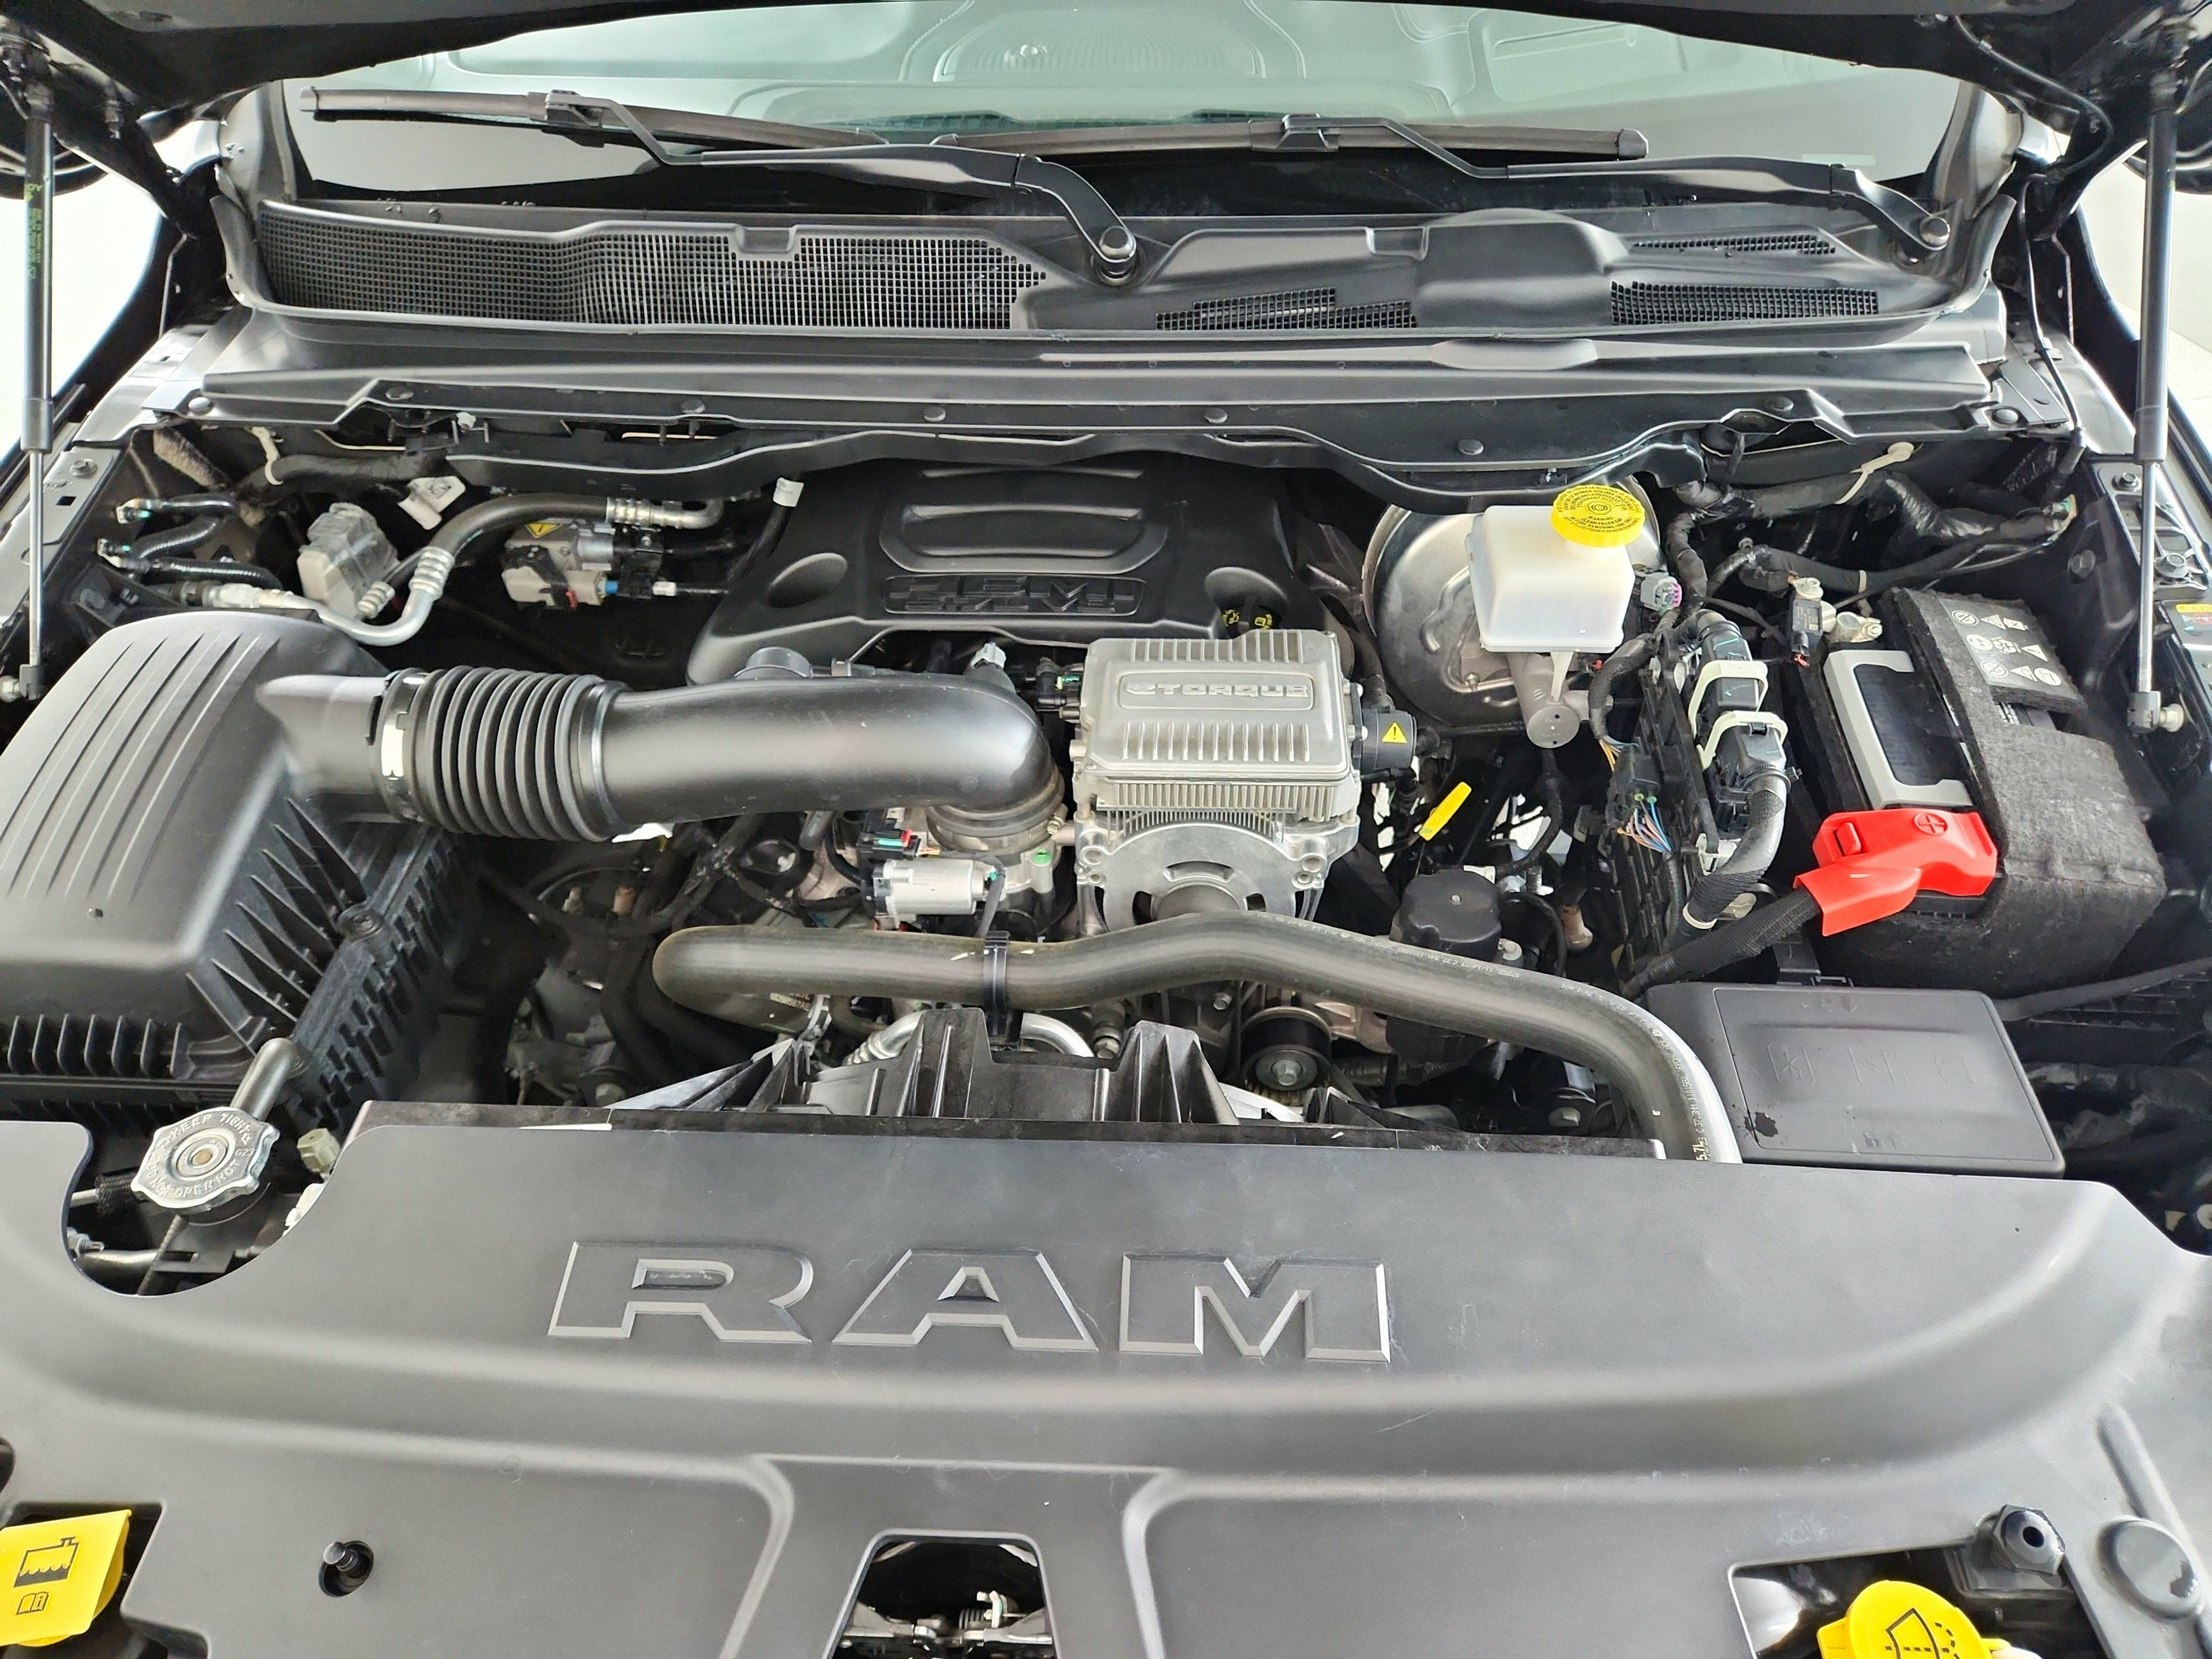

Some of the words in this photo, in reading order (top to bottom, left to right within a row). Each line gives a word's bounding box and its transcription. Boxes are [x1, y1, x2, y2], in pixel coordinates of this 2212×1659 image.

[170, 1113, 213, 1138] KEEP
[1692, 1144, 1708, 1161] 5.7L
[174, 1180, 214, 1198] OPEN
[214, 1158, 241, 1184] HOT
[548, 1240, 1392, 1363] RAM
